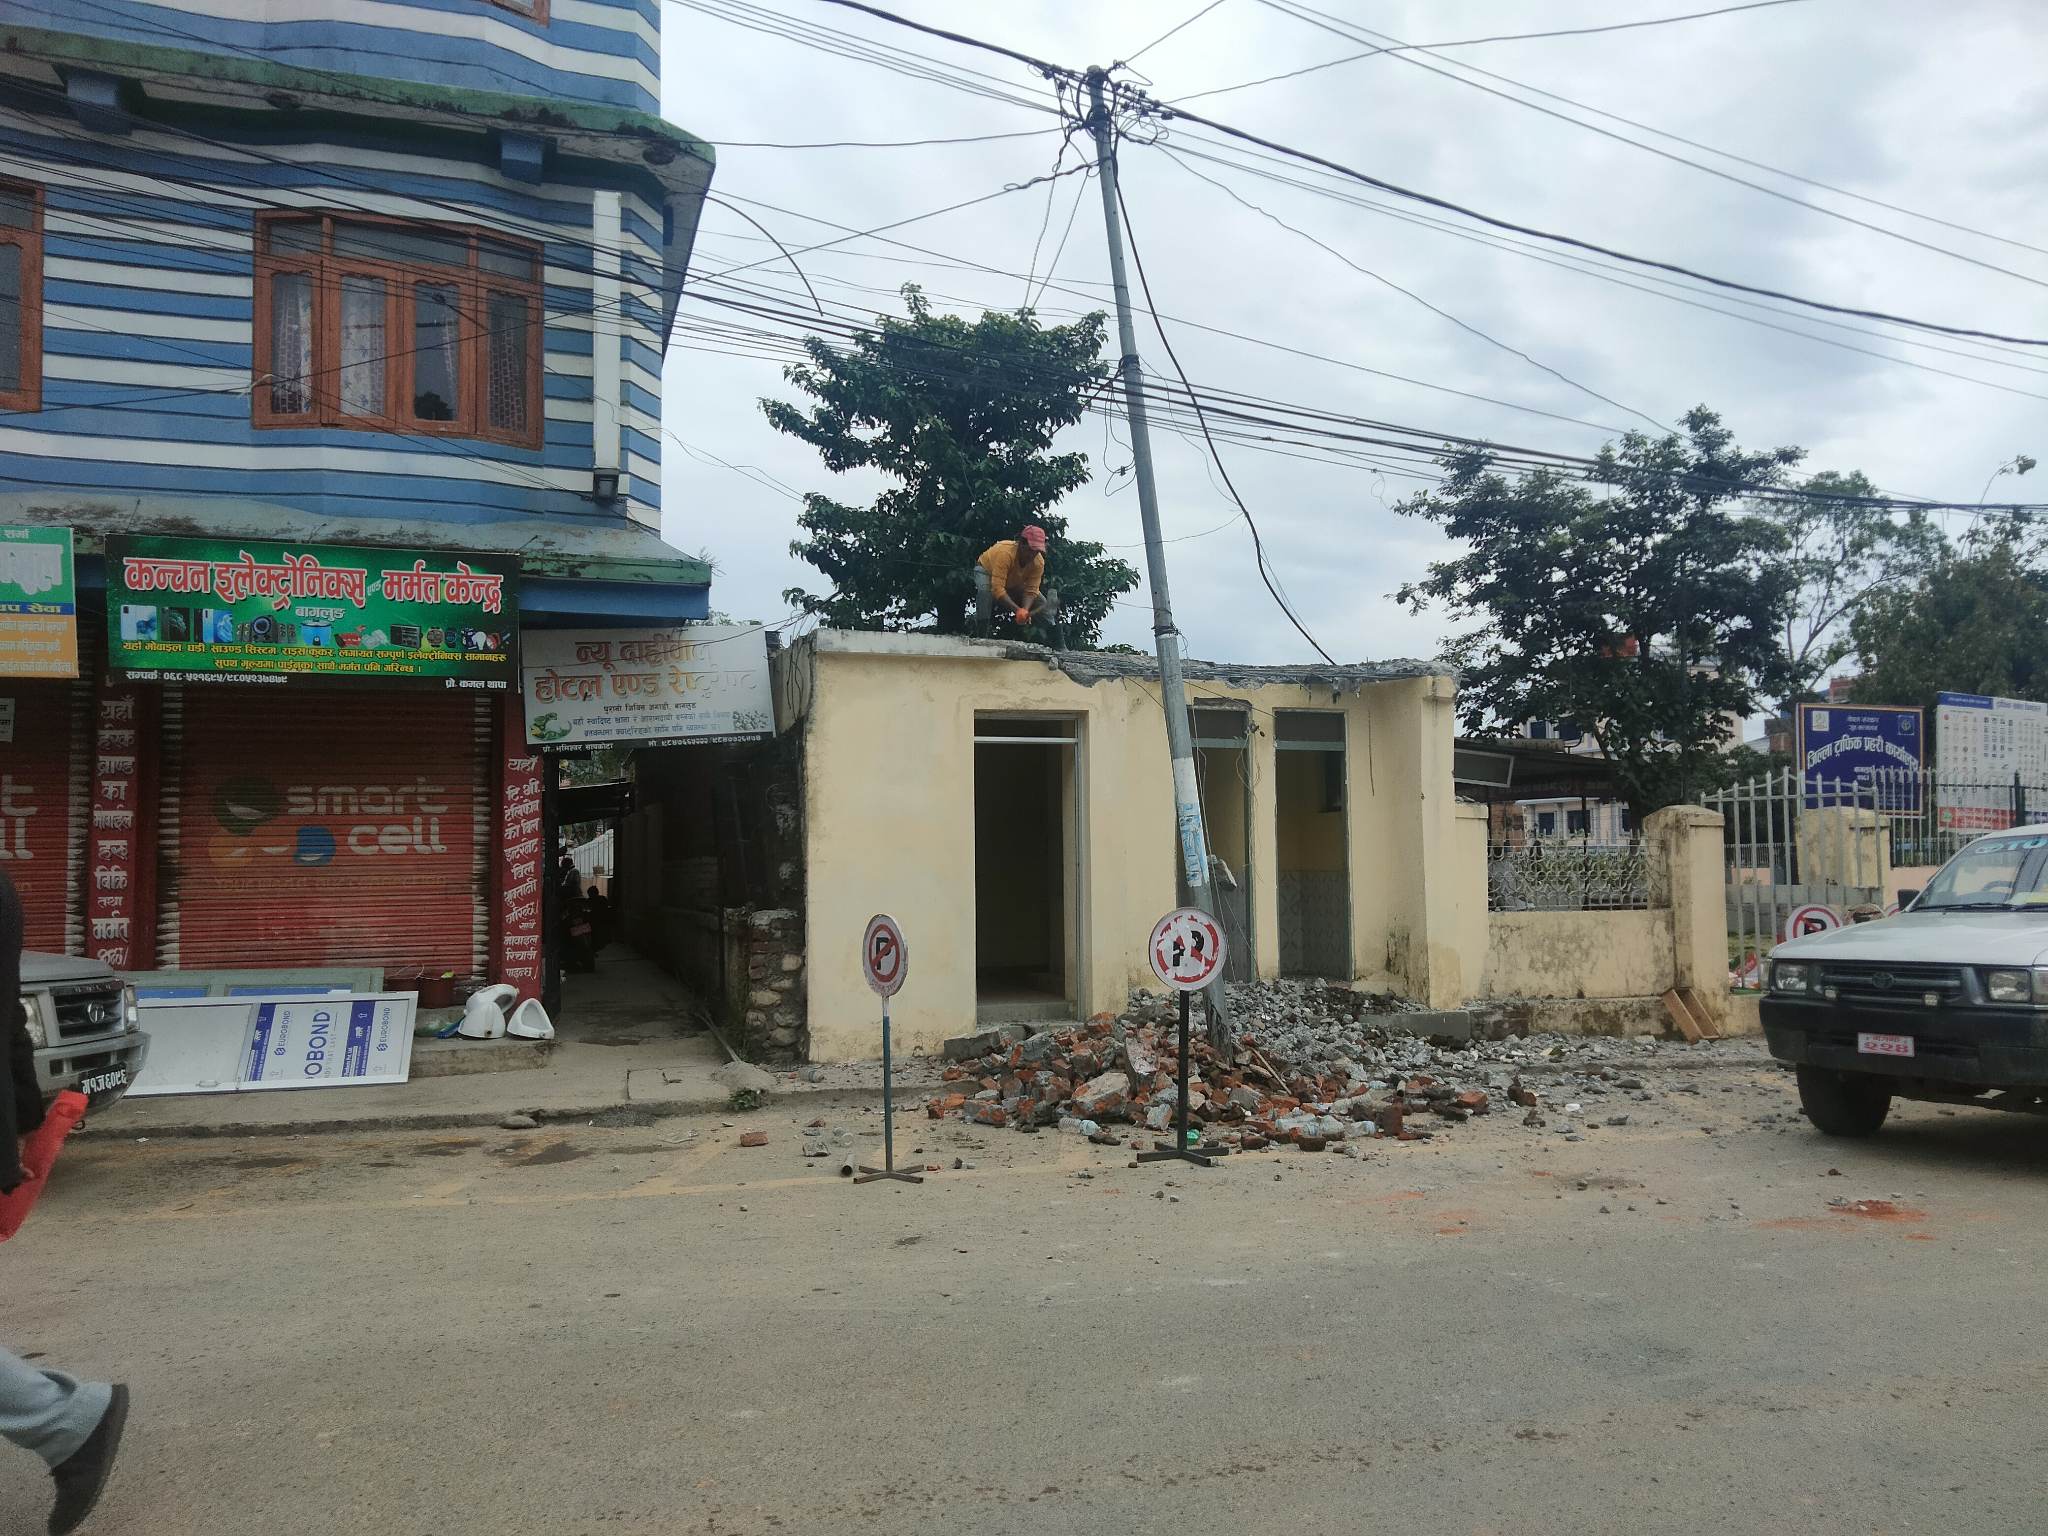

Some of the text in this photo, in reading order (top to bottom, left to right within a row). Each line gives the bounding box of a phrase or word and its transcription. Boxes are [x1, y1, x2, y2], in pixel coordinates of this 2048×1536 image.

[123, 556, 212, 595] कन्चन
[213, 550, 367, 612] इलेक्ट्रोनिक्स
[381, 559, 442, 604] मर्मत
[443, 560, 505, 615] केन्द्र
[287, 776, 449, 816] smart
[348, 816, 449, 855] cell
